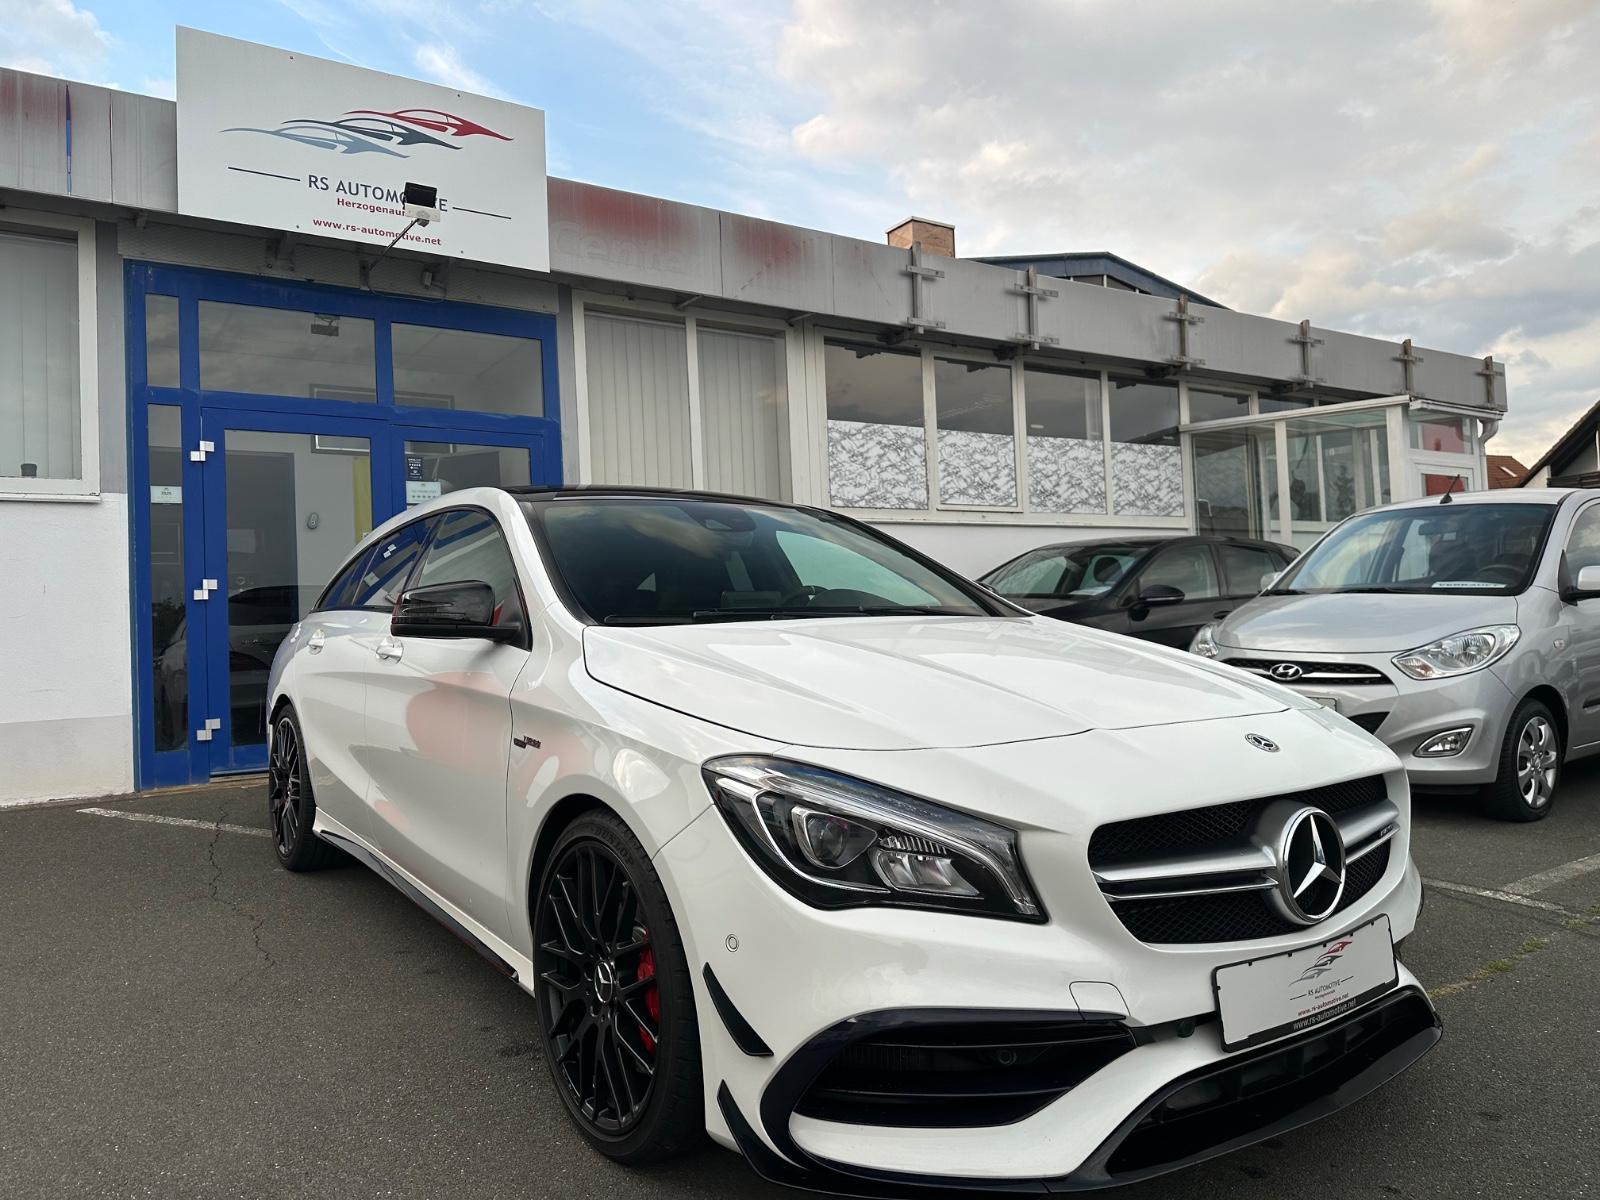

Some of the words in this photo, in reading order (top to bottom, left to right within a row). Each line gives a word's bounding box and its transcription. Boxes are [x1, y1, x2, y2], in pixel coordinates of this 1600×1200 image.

[308, 174, 329, 190] RS
[336, 180, 448, 212] AUTOME
[337, 197, 406, 217] Herzogenaur
